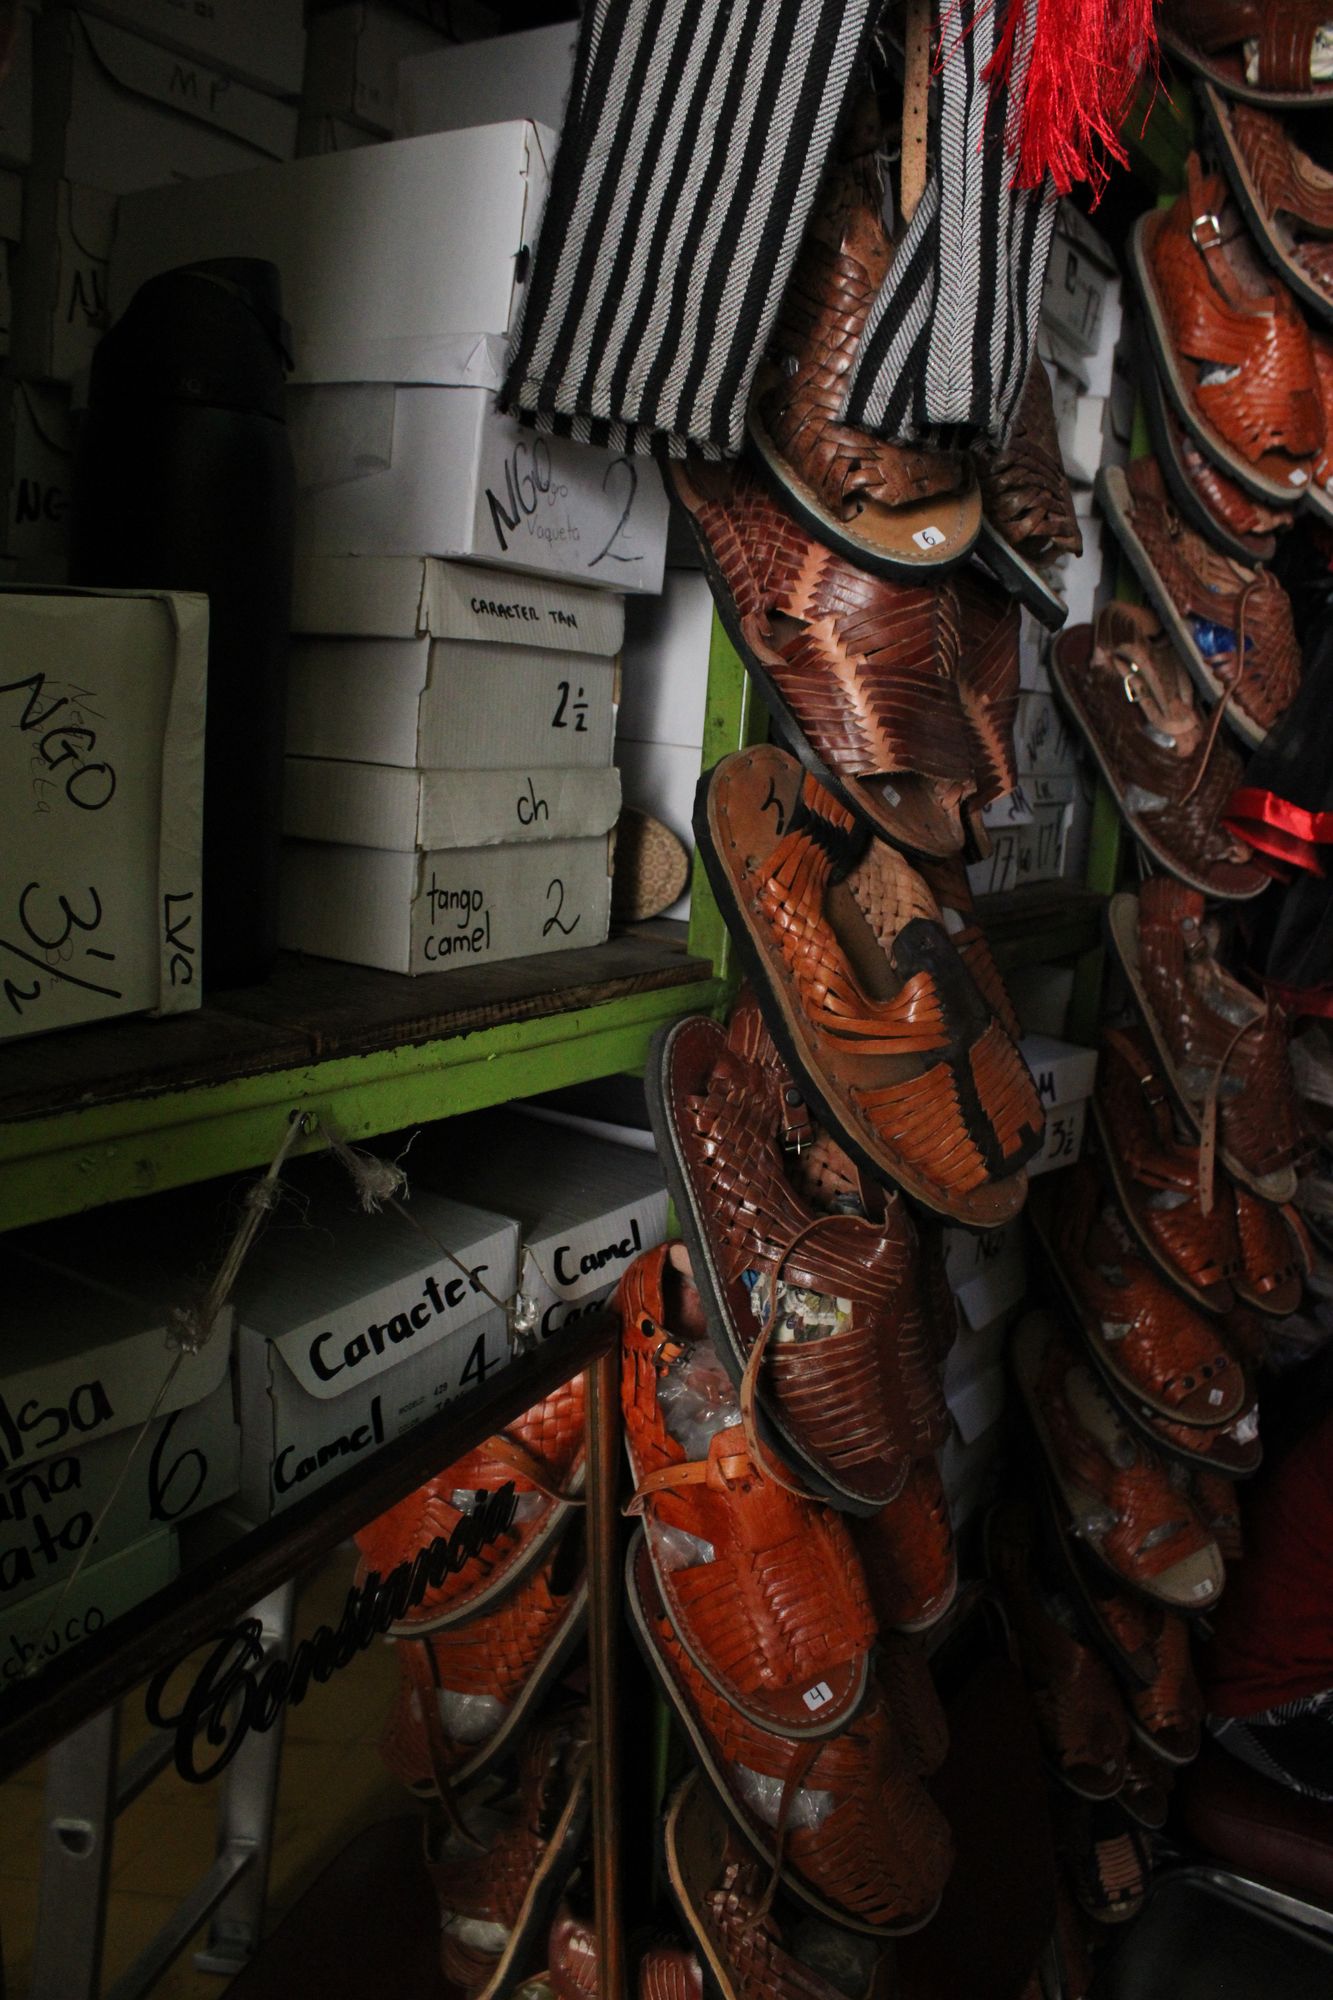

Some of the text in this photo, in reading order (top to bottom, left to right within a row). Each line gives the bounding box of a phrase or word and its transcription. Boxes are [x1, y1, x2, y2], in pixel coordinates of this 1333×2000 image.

[484, 437, 643, 567] NGO 2
[922, 531, 936, 546] 6
[470, 597, 577, 628] CARACTER TAN
[517, 777, 549, 825] ch
[427, 872, 581, 937] tango 2
[554, 1219, 642, 1286] Camel
[309, 1264, 489, 1382] Caracter
[459, 1333, 500, 1387] 4
[148, 1408, 207, 1522] 6
[274, 1395, 383, 1494] Camel
[809, 1686, 826, 1702] 4
